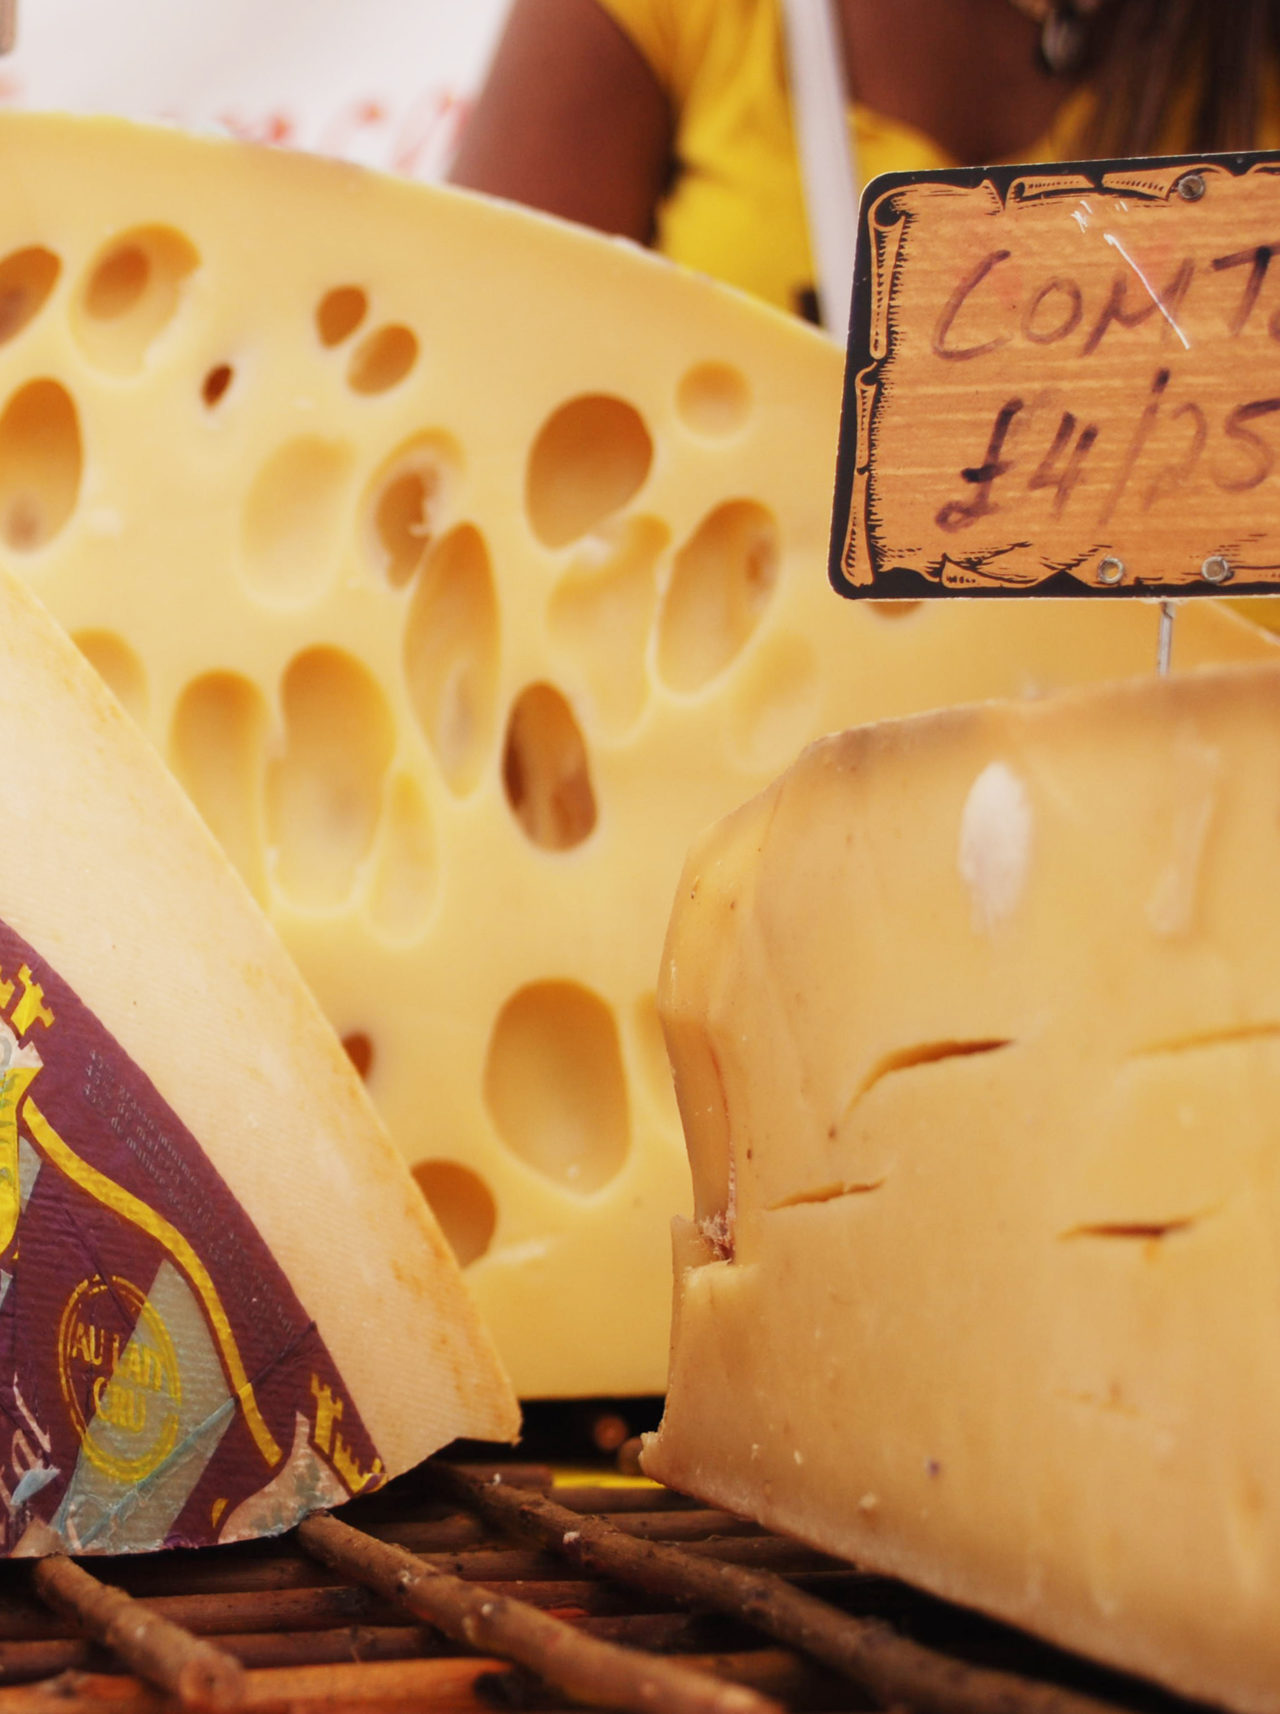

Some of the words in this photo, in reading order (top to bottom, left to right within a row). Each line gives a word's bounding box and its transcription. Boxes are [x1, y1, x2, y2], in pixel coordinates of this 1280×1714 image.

[932, 241, 1280, 361] COMT
[71, 1322, 105, 1366] AU
[112, 1334, 163, 1391] LAIT
[93, 1376, 147, 1433] CRU
